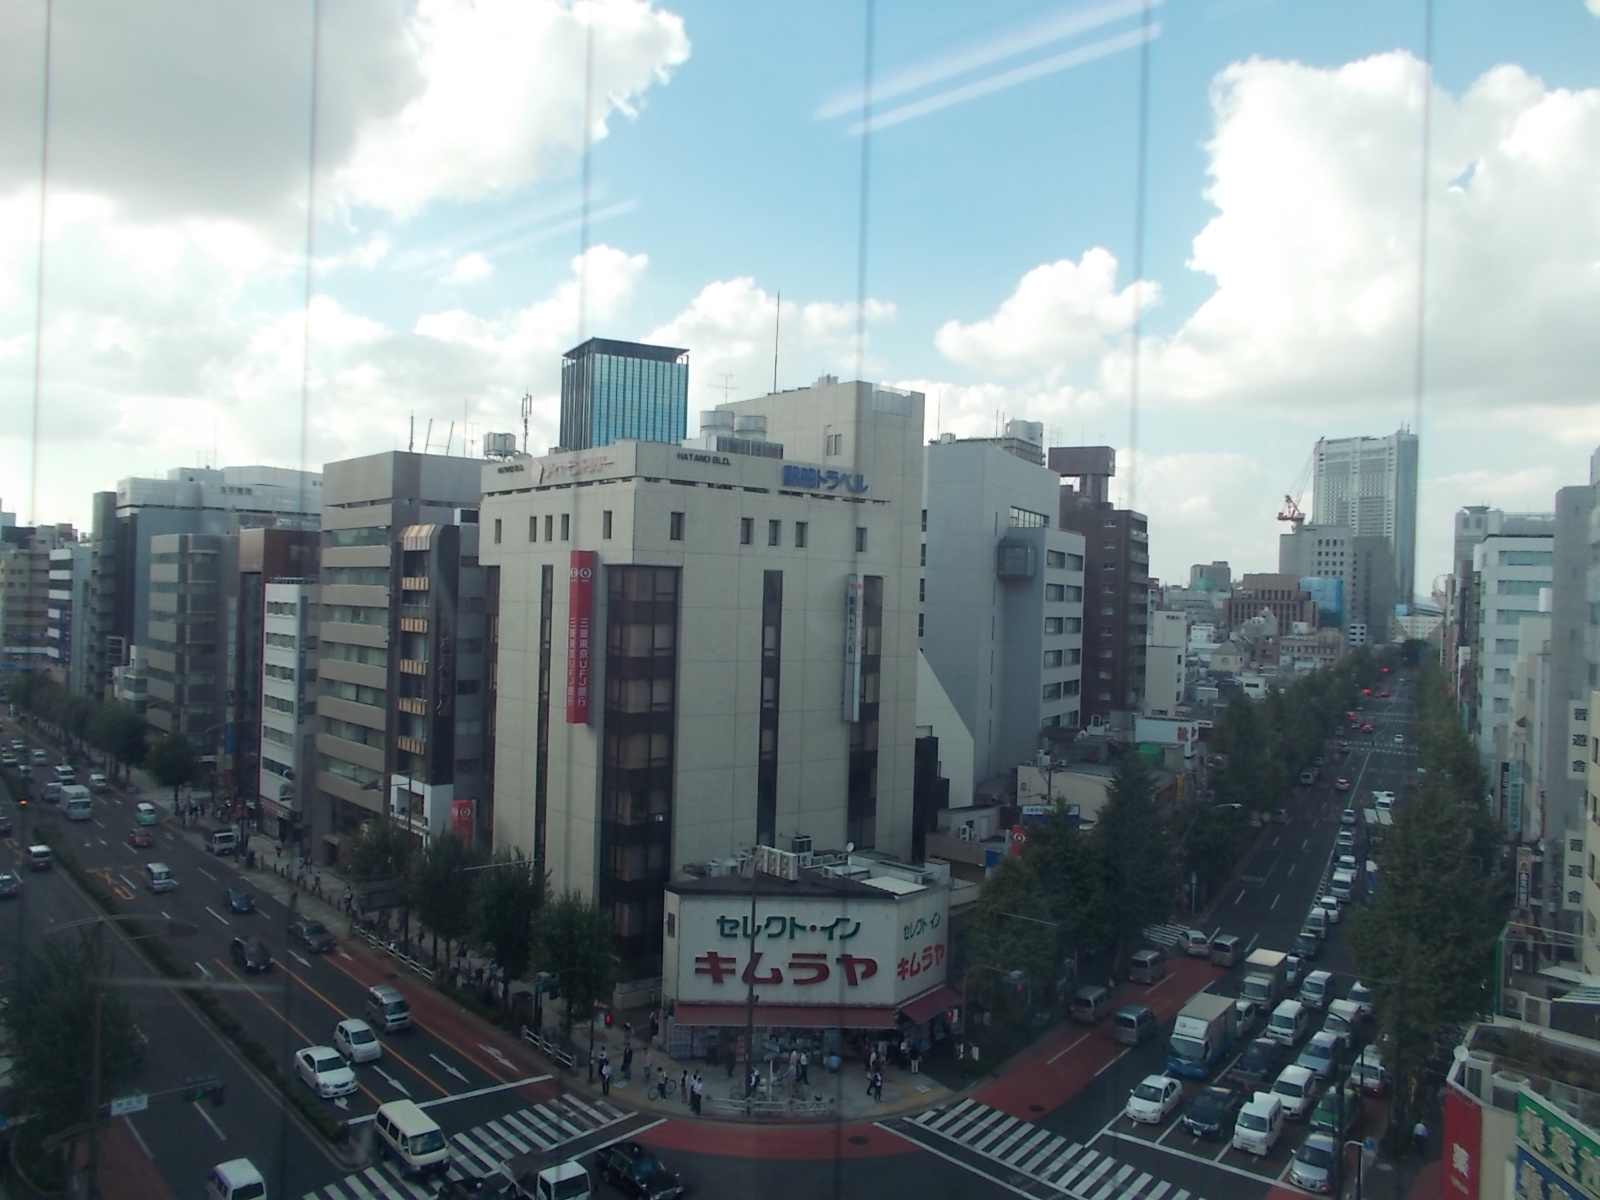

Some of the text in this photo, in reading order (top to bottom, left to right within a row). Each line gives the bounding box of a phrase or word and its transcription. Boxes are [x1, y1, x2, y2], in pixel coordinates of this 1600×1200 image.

[677, 452, 710, 464] HATANO
[903, 912, 940, 940] セレクトイン
[695, 951, 877, 986] キムラヤ
[897, 943, 945, 980] キムラヤ
